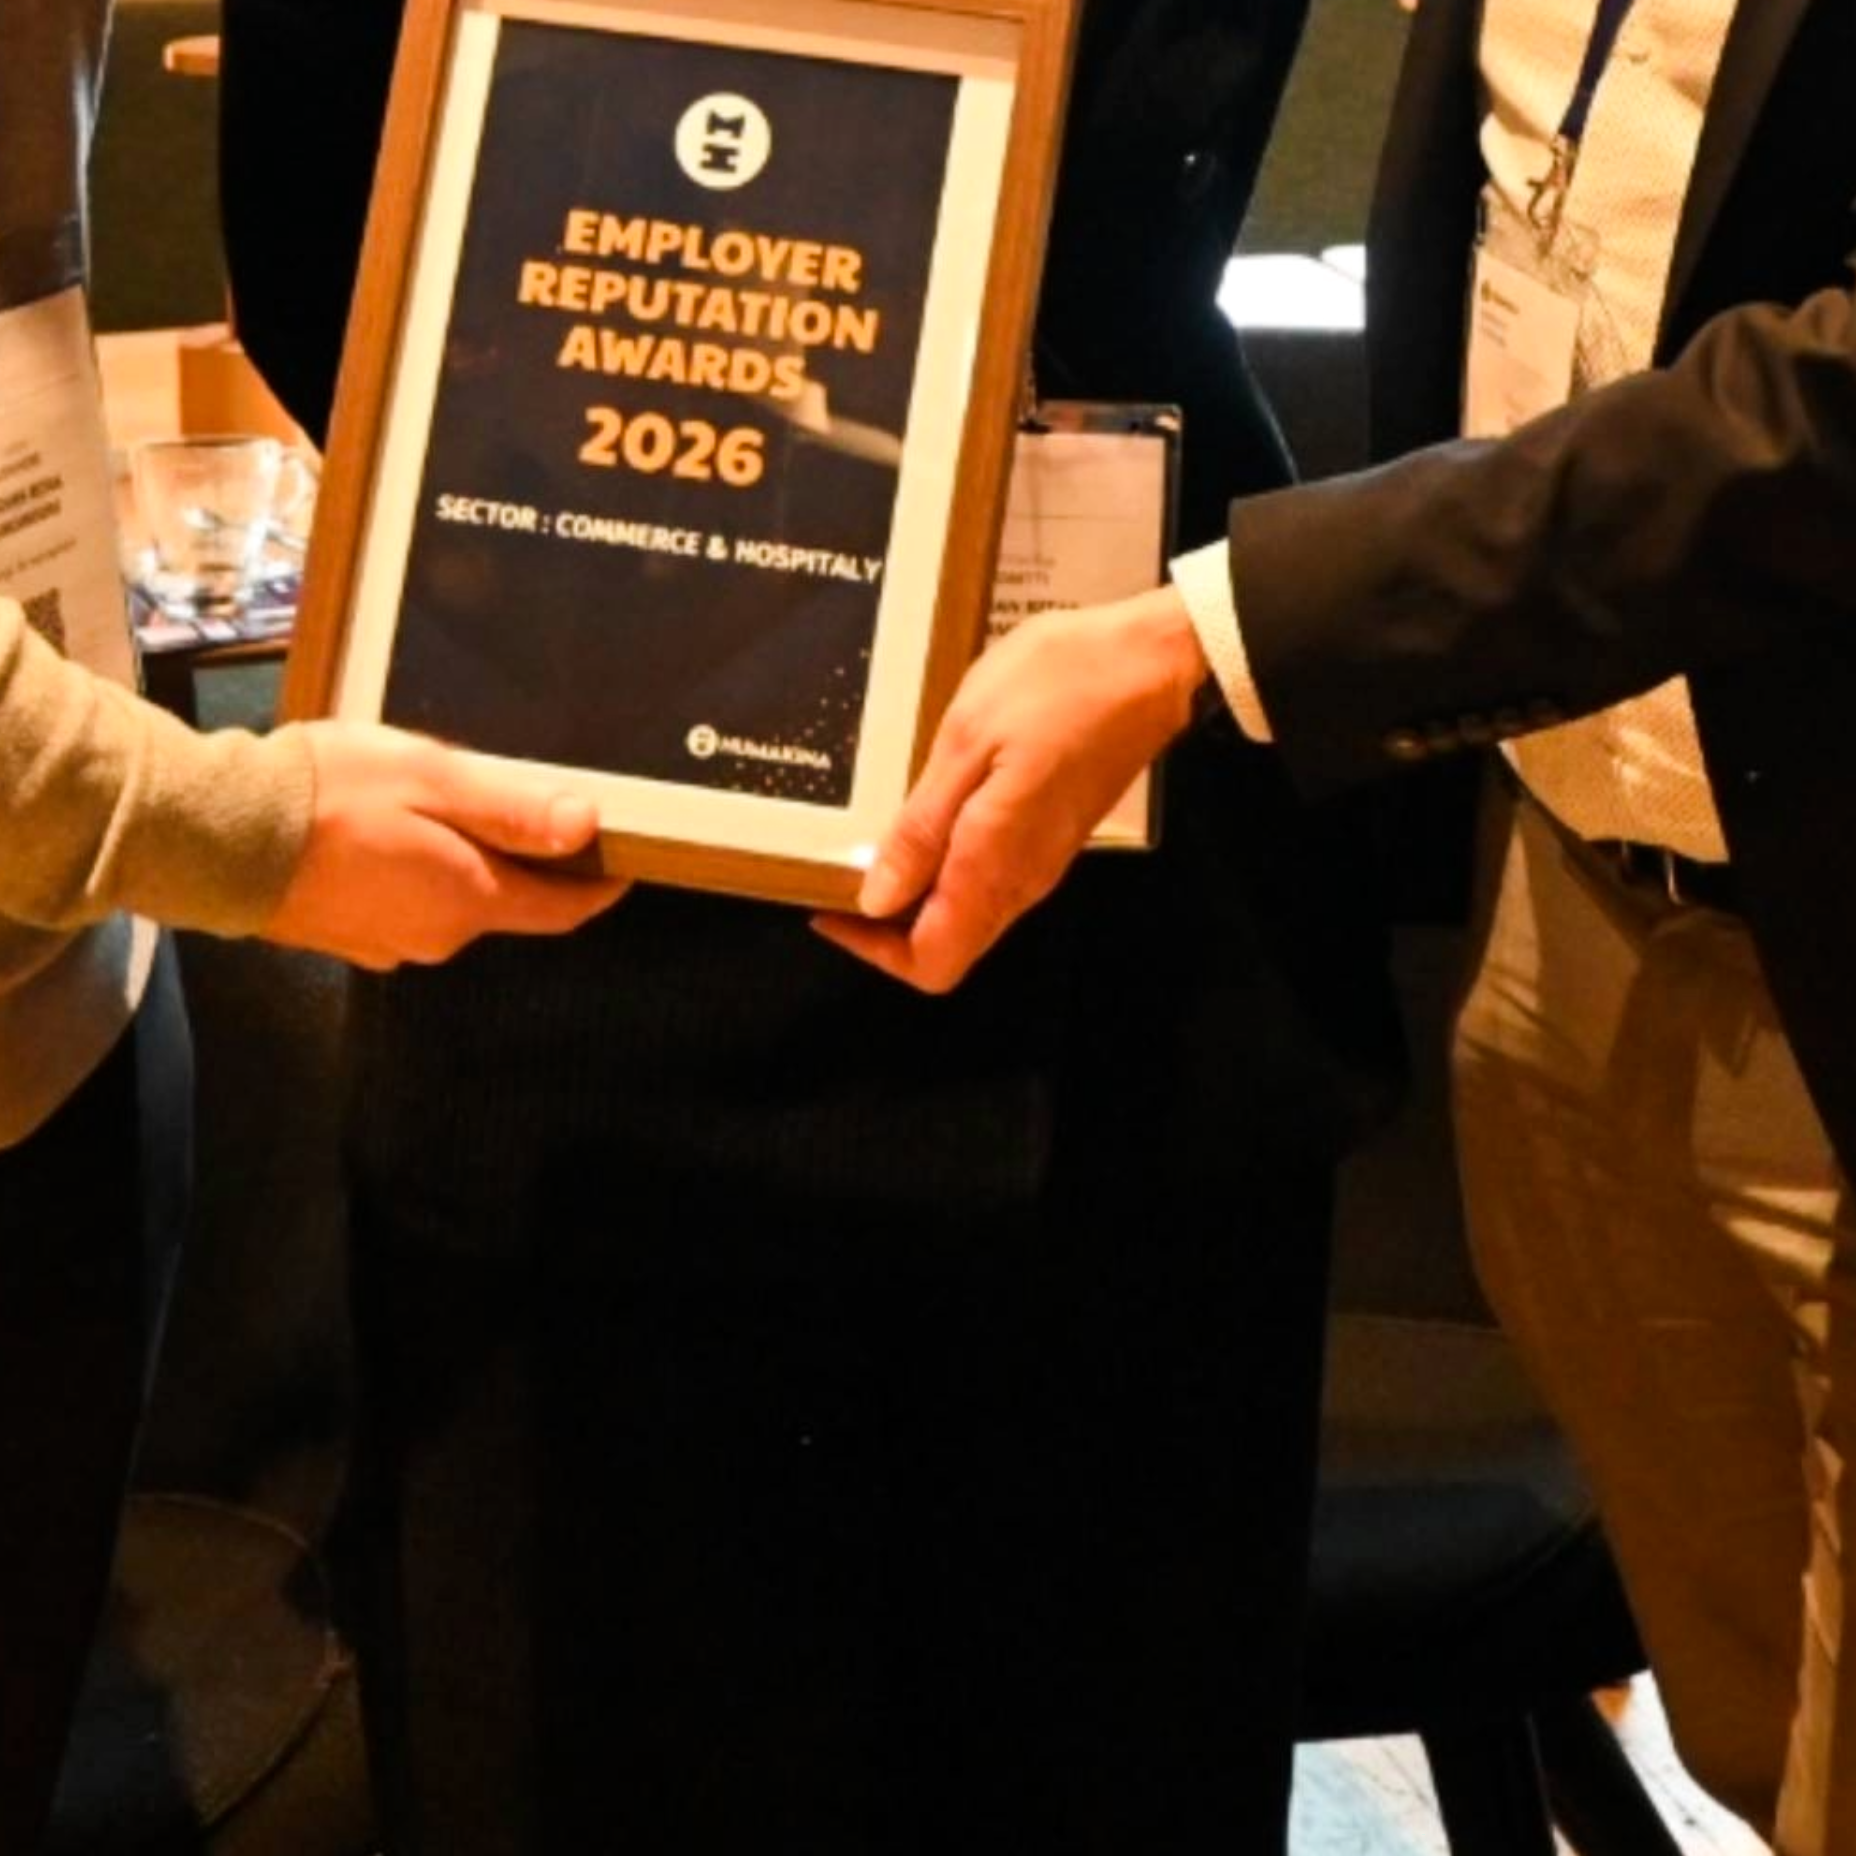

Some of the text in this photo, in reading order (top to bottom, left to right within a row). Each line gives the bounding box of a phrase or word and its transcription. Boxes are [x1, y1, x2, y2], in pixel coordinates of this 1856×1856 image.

[564, 208, 863, 294] EMPLOYER
[518, 260, 879, 354] REPUTATION
[557, 324, 806, 401] AWARDS
[578, 406, 765, 488] 2026
[435, 493, 538, 533] SECTOR
[555, 510, 702, 557] COMMERCE
[705, 534, 728, 561] &
[735, 539, 883, 584] HOSPITALY
